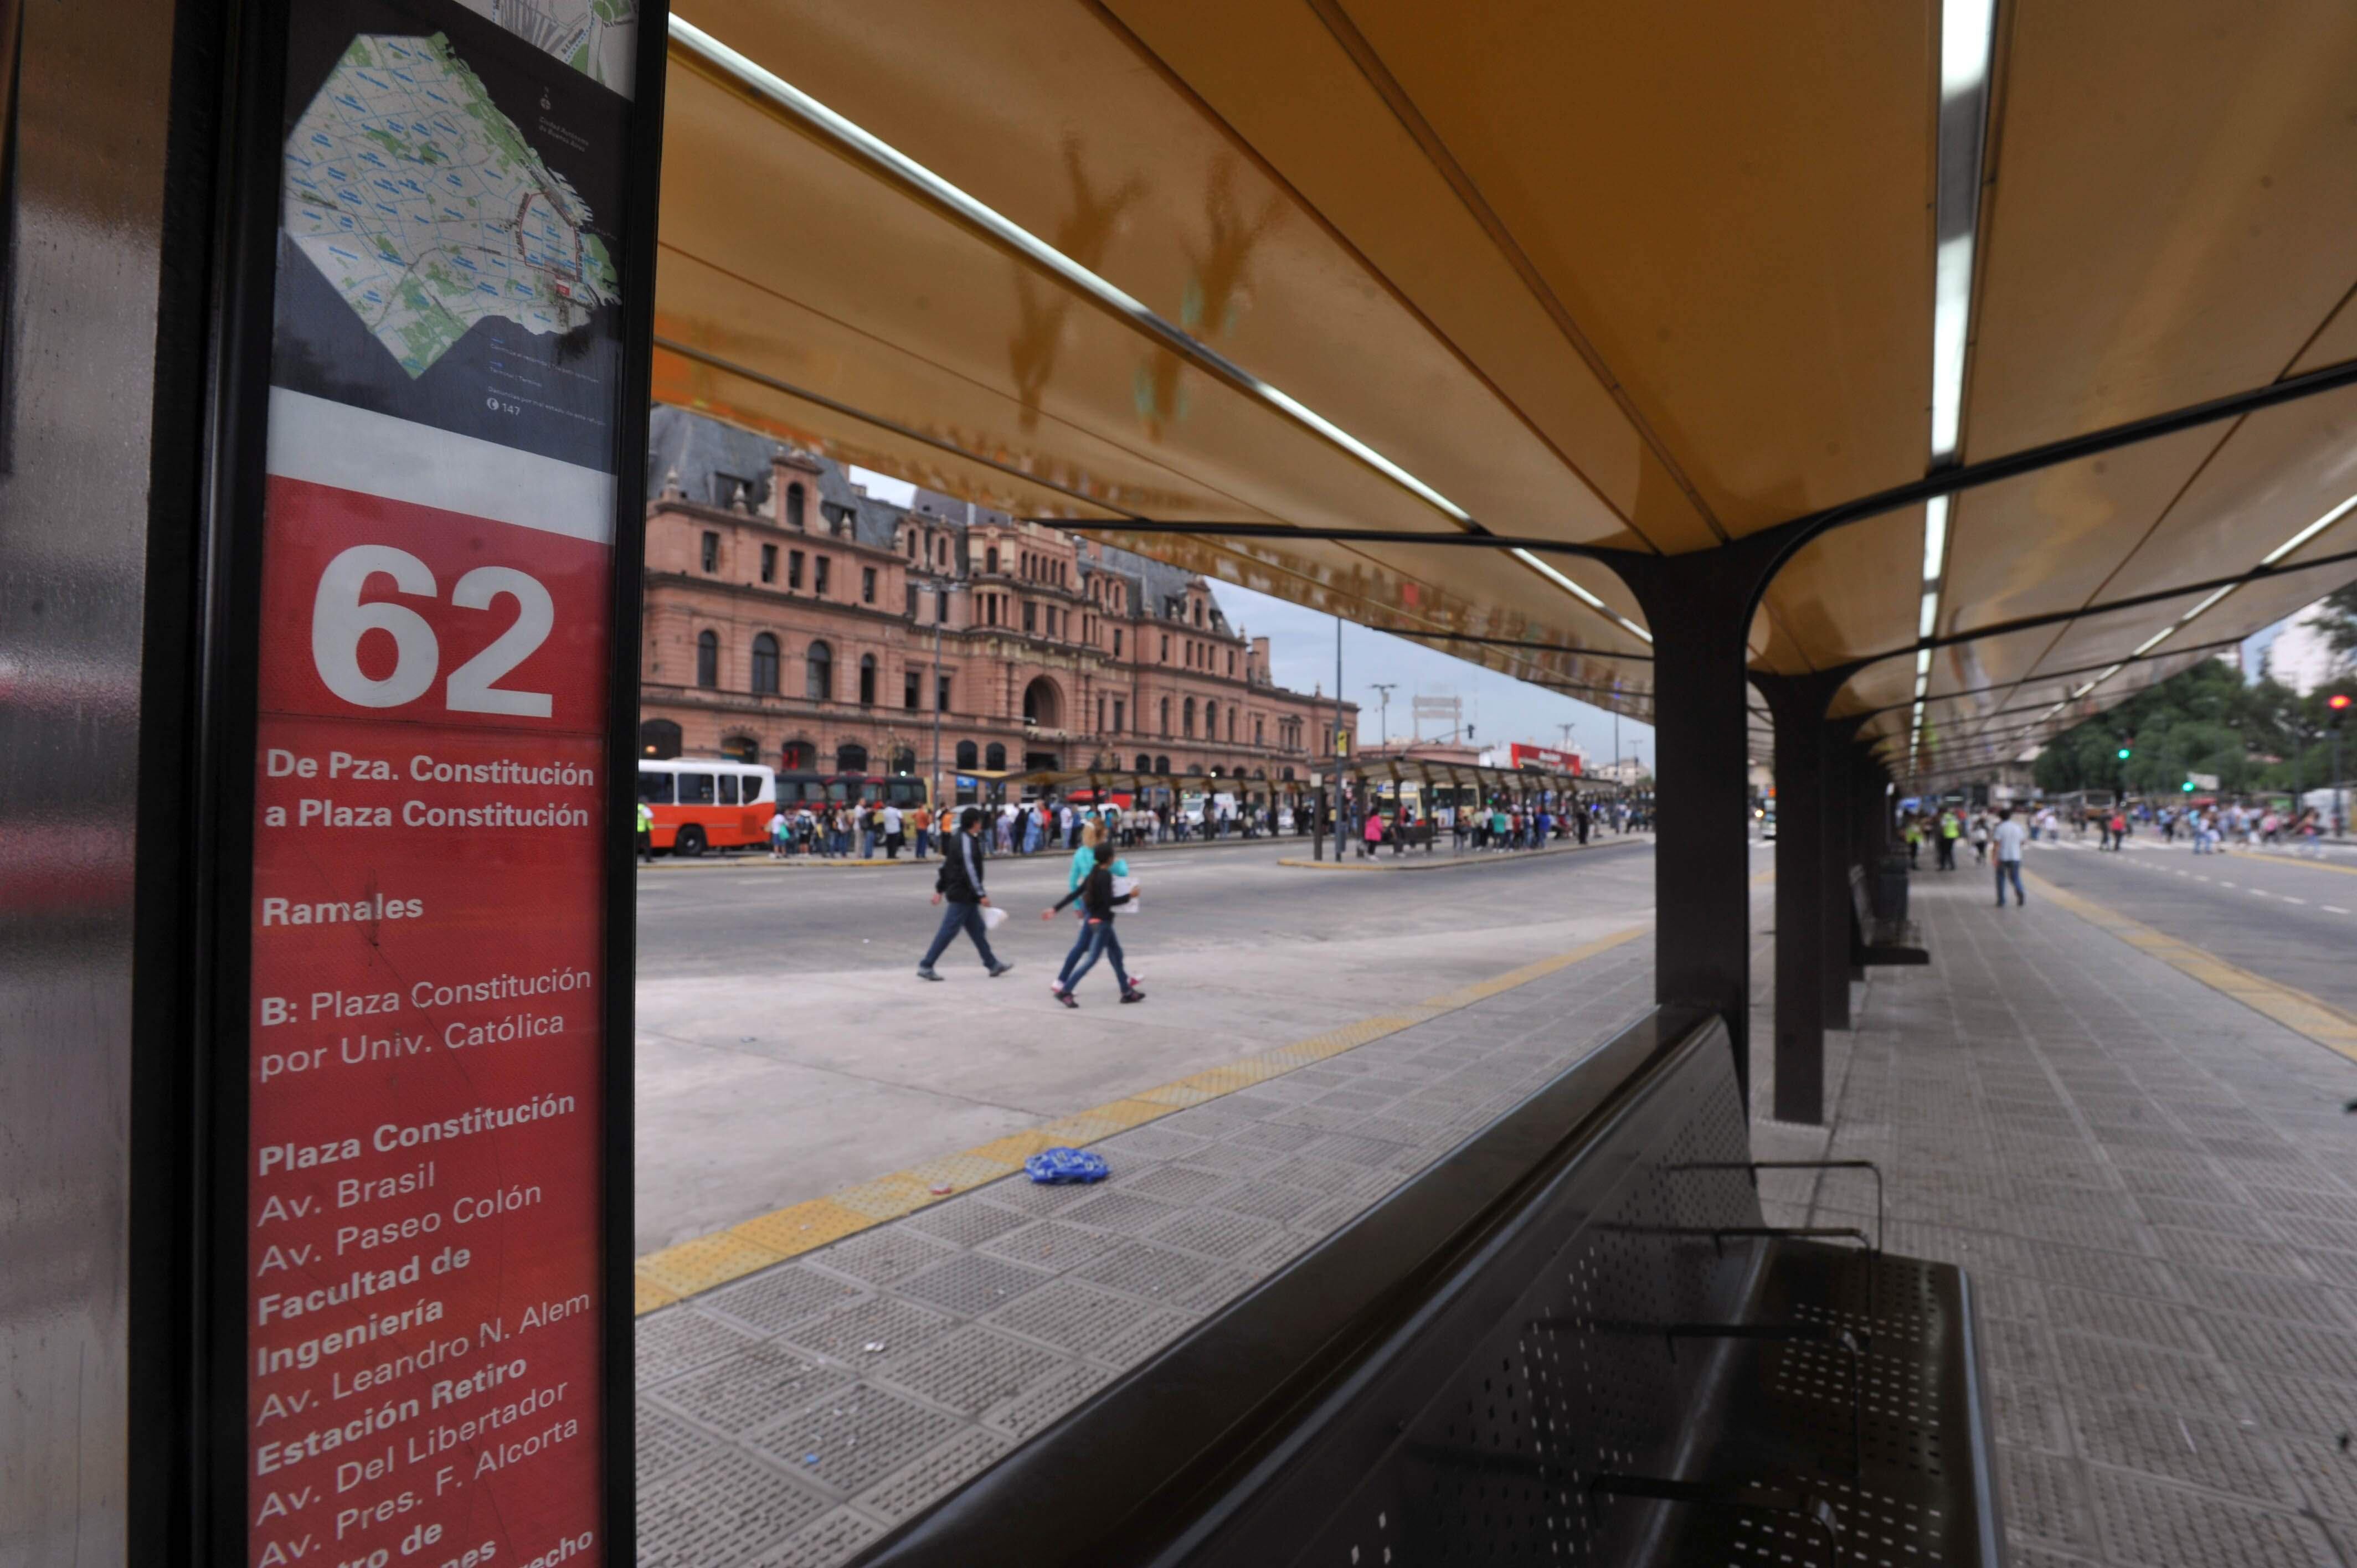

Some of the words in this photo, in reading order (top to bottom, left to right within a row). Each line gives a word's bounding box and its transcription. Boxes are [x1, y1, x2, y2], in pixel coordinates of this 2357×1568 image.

[502, 403, 521, 415] 147
[312, 544, 554, 718] 62
[267, 749, 318, 778] De
[330, 751, 399, 780] Pza.
[410, 755, 594, 786] Constitución
[265, 806, 286, 827] a
[299, 799, 392, 827] Plaza
[403, 800, 588, 827] Constitución
[263, 893, 423, 926] Ramales
[261, 997, 297, 1026] B:
[311, 991, 399, 1020] Plaza
[411, 967, 590, 1008] Constitución
[261, 1048, 327, 1083] por
[342, 1033, 431, 1064] Univ.
[445, 1013, 564, 1049] Católica
[259, 1138, 361, 1176] Plaza
[373, 1093, 575, 1152] Constitución
[257, 1195, 321, 1227] Av.
[338, 1161, 434, 1208] Brasil
[257, 1244, 321, 1277] Av.
[337, 1213, 441, 1255] Paseo
[453, 1185, 541, 1224] Colón
[259, 1255, 419, 1326] Facultad
[431, 1246, 471, 1275] de
[256, 1390, 319, 1426] Av.
[333, 1337, 469, 1400] Leandro
[480, 1318, 510, 1348] N.
[519, 1294, 589, 1334] Alem
[258, 1298, 443, 1376] Ingeniería
[256, 1486, 321, 1526] Av.
[337, 1446, 393, 1493] Del
[409, 1382, 568, 1463] Libertador
[257, 1399, 419, 1476] Estación
[432, 1359, 527, 1409] Retiro
[259, 1534, 321, 1568] Av.
[337, 1492, 423, 1540] Pres.
[436, 1466, 462, 1496] F.
[474, 1419, 577, 1479] Alcorta
[401, 1524, 442, 1555] de
